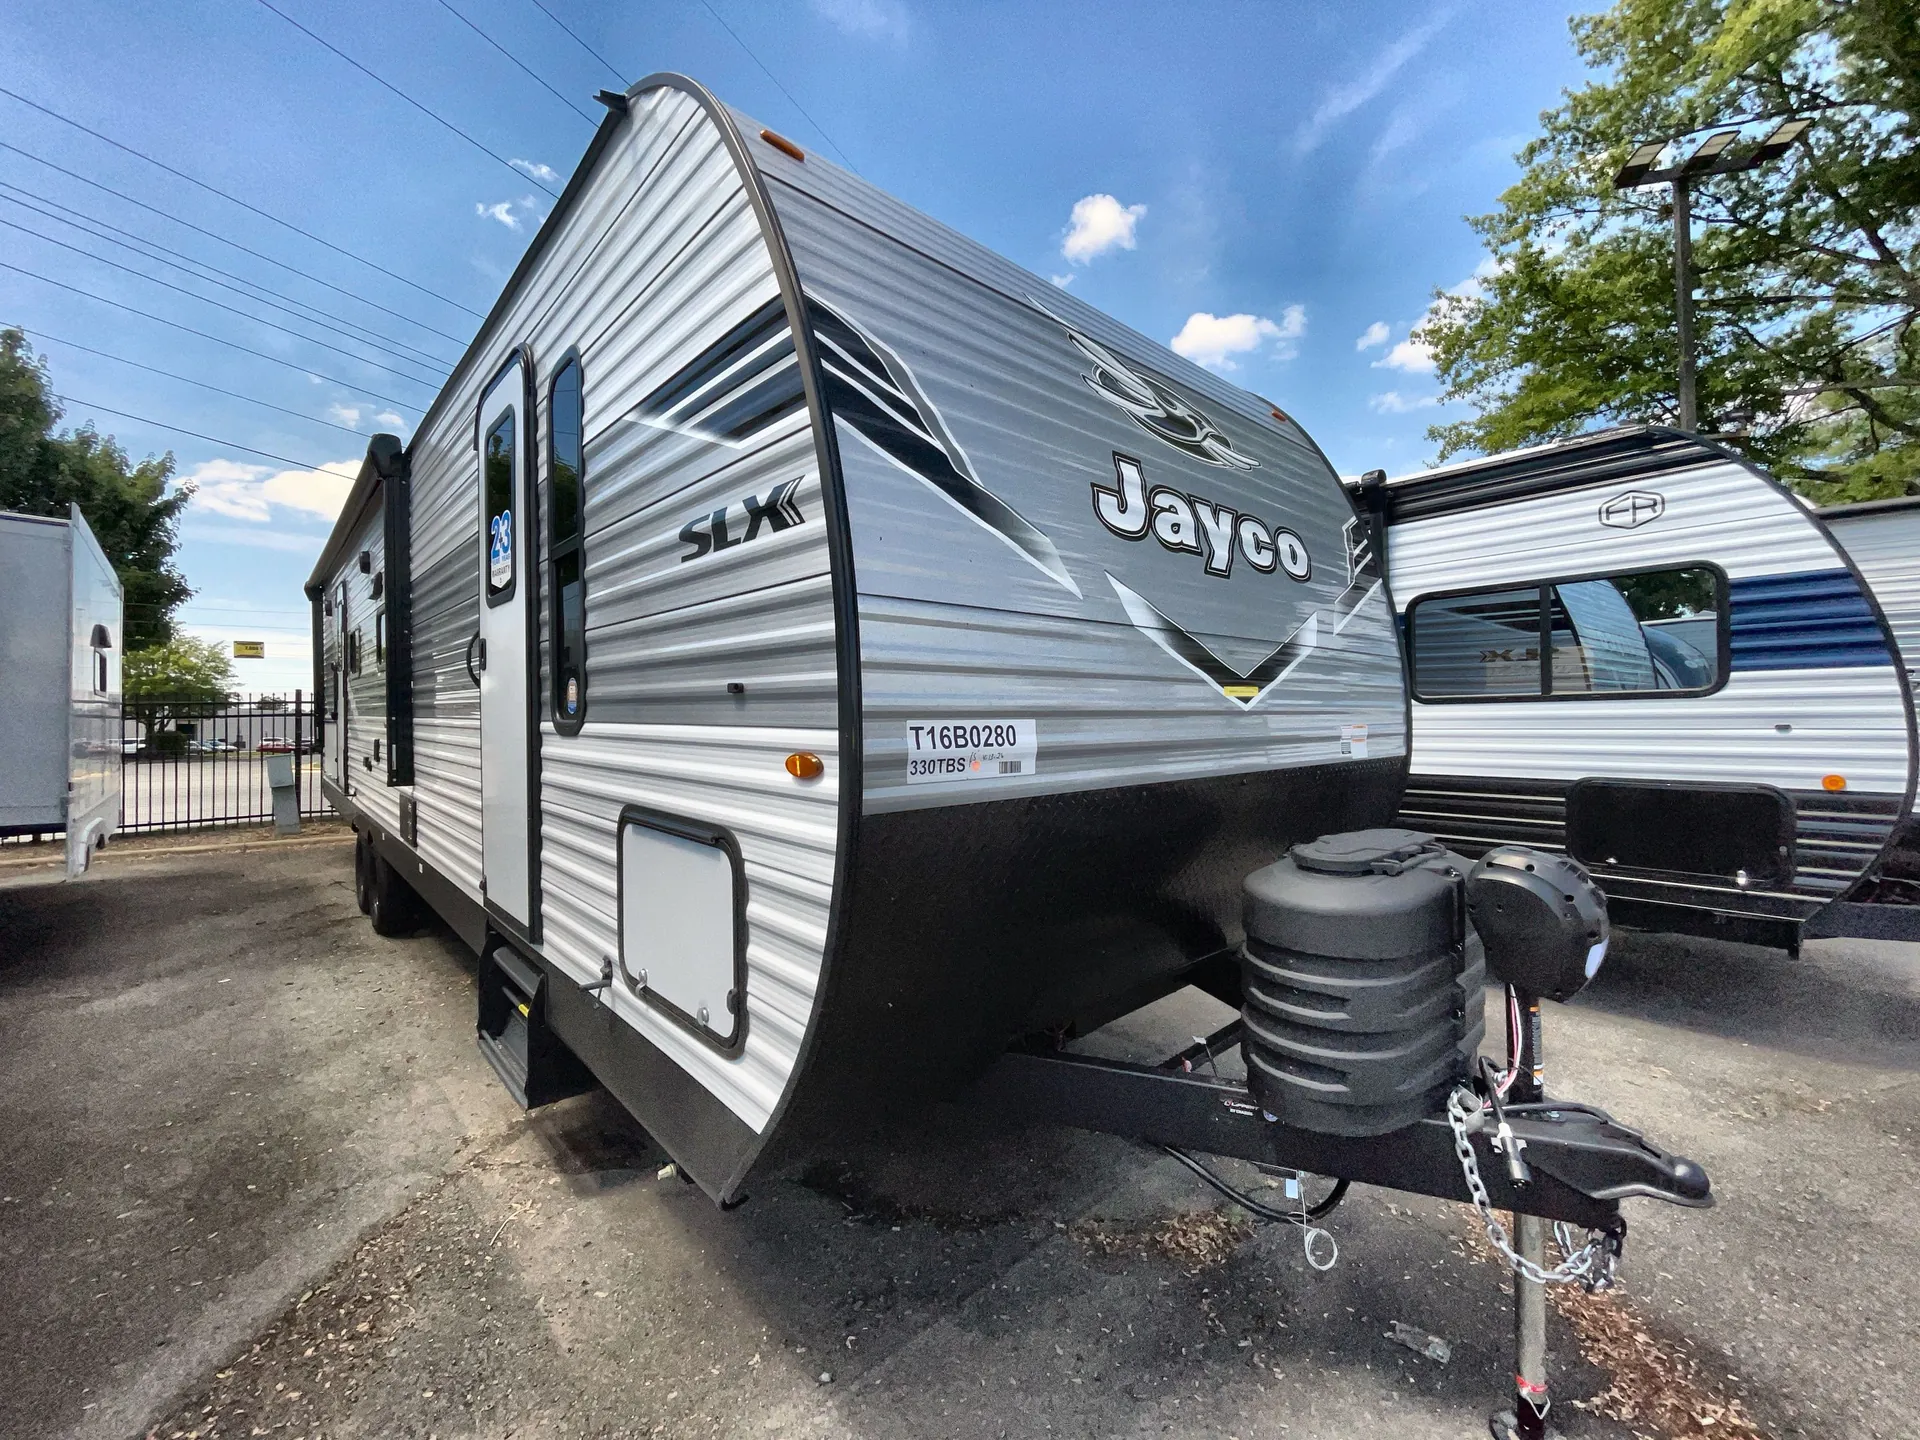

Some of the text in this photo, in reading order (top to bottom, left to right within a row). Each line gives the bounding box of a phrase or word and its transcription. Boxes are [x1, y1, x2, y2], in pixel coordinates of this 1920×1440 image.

[679, 475, 805, 563] SLX
[1090, 450, 1311, 583] Jayco
[909, 725, 1017, 750] T16B0280
[910, 758, 966, 776] 330TBS
